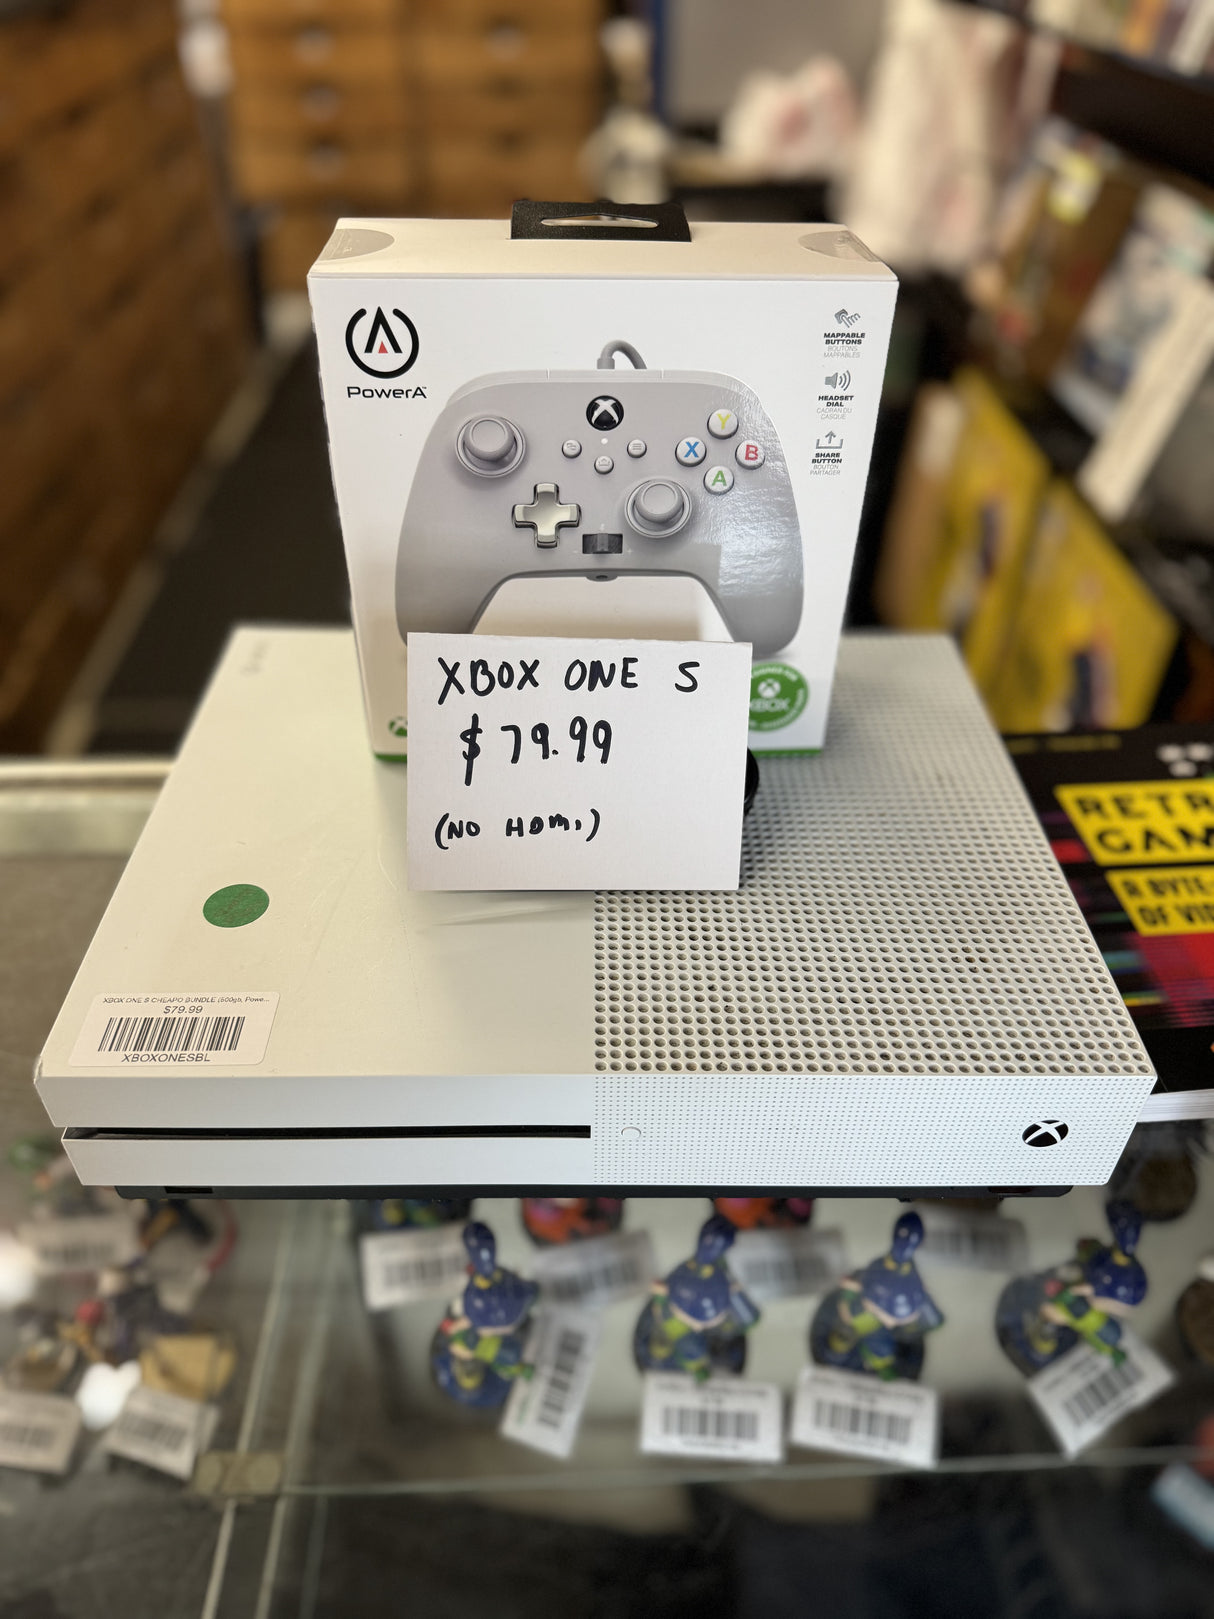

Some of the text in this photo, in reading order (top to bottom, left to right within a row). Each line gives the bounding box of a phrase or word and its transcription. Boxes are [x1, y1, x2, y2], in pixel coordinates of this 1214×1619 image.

[716, 413, 732, 430] Y
[683, 441, 700, 458] X
[744, 445, 759, 461] B
[711, 470, 728, 487] A
[437, 656, 700, 705] XBOX ONE S
[434, 812, 481, 850] (NO
[163, 1005, 203, 1014] $79.99
[121, 1053, 211, 1063] XBOXONESBL
